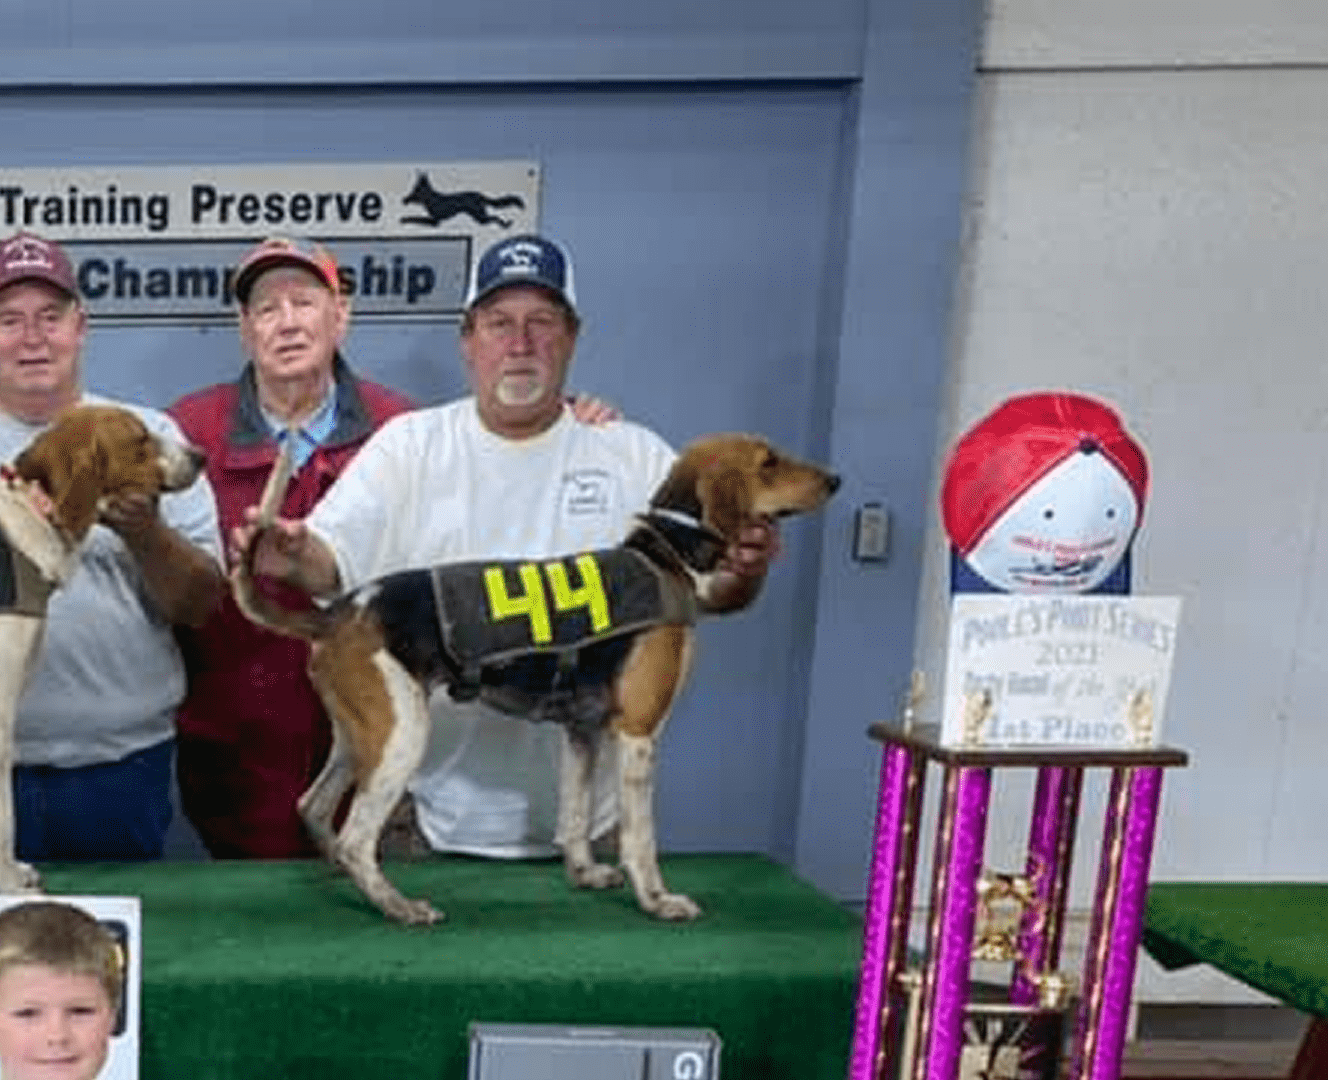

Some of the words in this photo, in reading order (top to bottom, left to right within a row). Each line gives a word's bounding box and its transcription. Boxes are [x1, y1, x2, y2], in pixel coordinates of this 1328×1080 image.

[0, 186, 169, 231] Training
[191, 185, 383, 225] Preserve
[484, 552, 611, 646] 44
